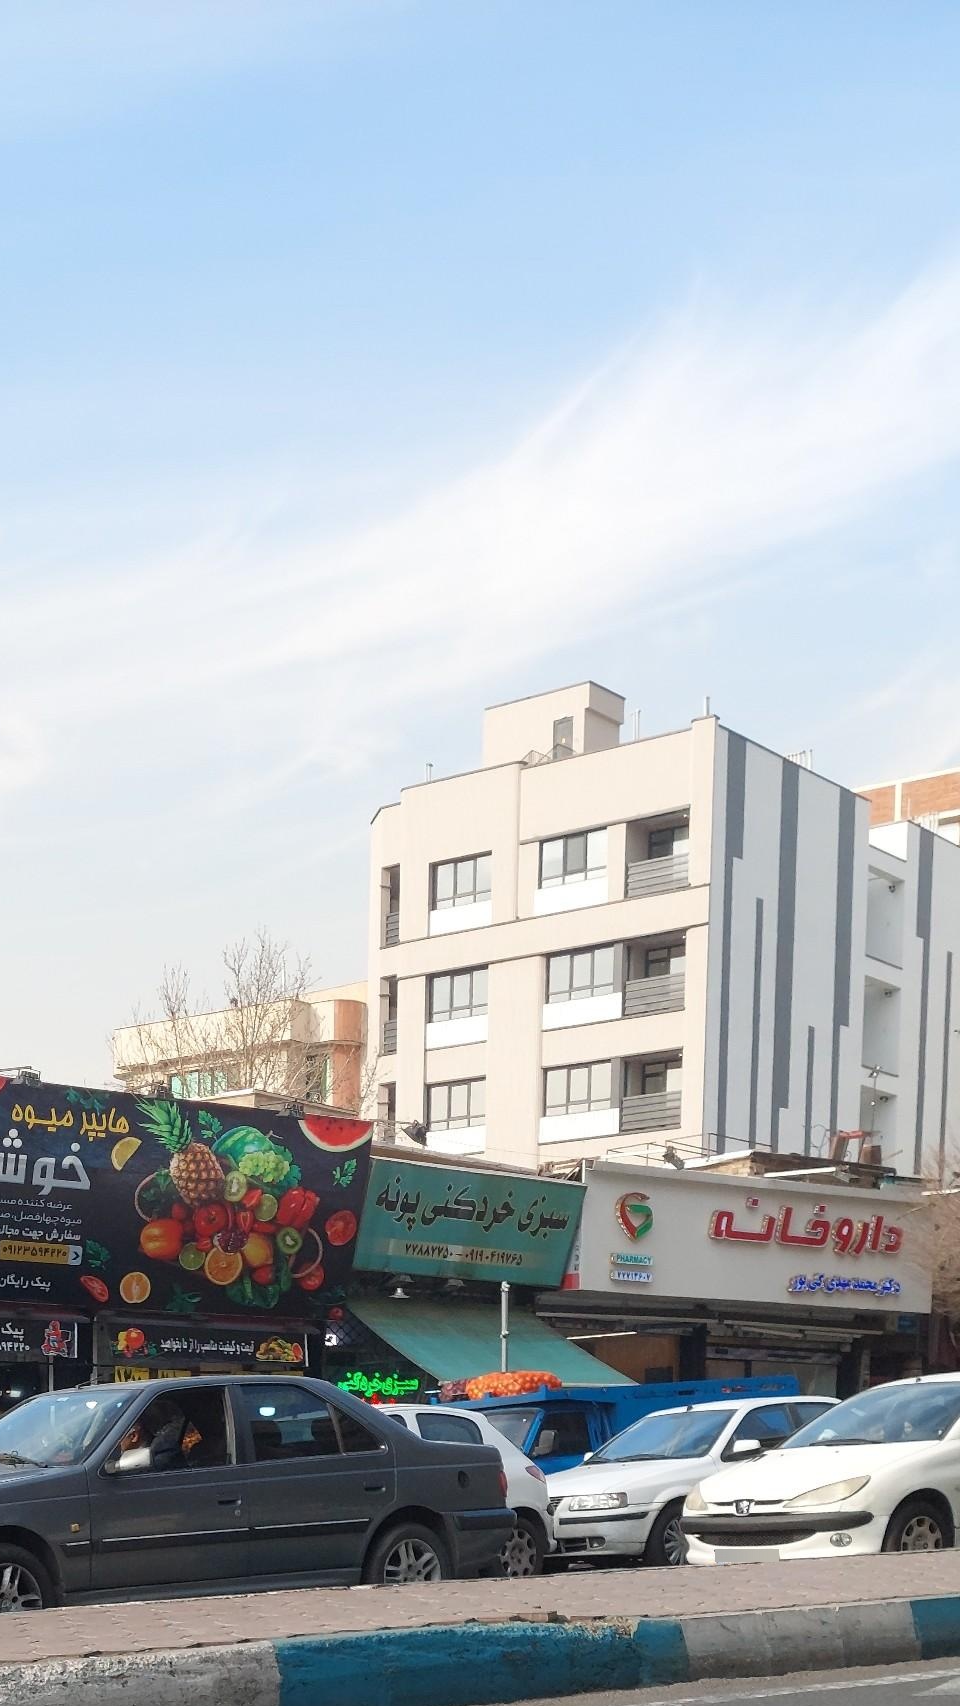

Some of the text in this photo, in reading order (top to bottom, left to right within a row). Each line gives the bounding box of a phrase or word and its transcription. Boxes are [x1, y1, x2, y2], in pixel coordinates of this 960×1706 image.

[11, 1103, 130, 1141] هایپر میوه
[17, 1197, 45, 1208] کننده
[46, 1201, 73, 1211] عرضه
[375, 1175, 421, 1232] پونه
[60, 1215, 82, 1227] میوه
[517, 1195, 570, 1239] سبزی
[22, 1228, 44, 1240] جهت
[708, 1197, 904, 1256] داروخانه
[45, 1229, 81, 1242] سفارش
[616, 1254, 652, 1265] PHARMACY
[31, 1275, 51, 1292] پیک
[1, 1321, 25, 1341] پیک
